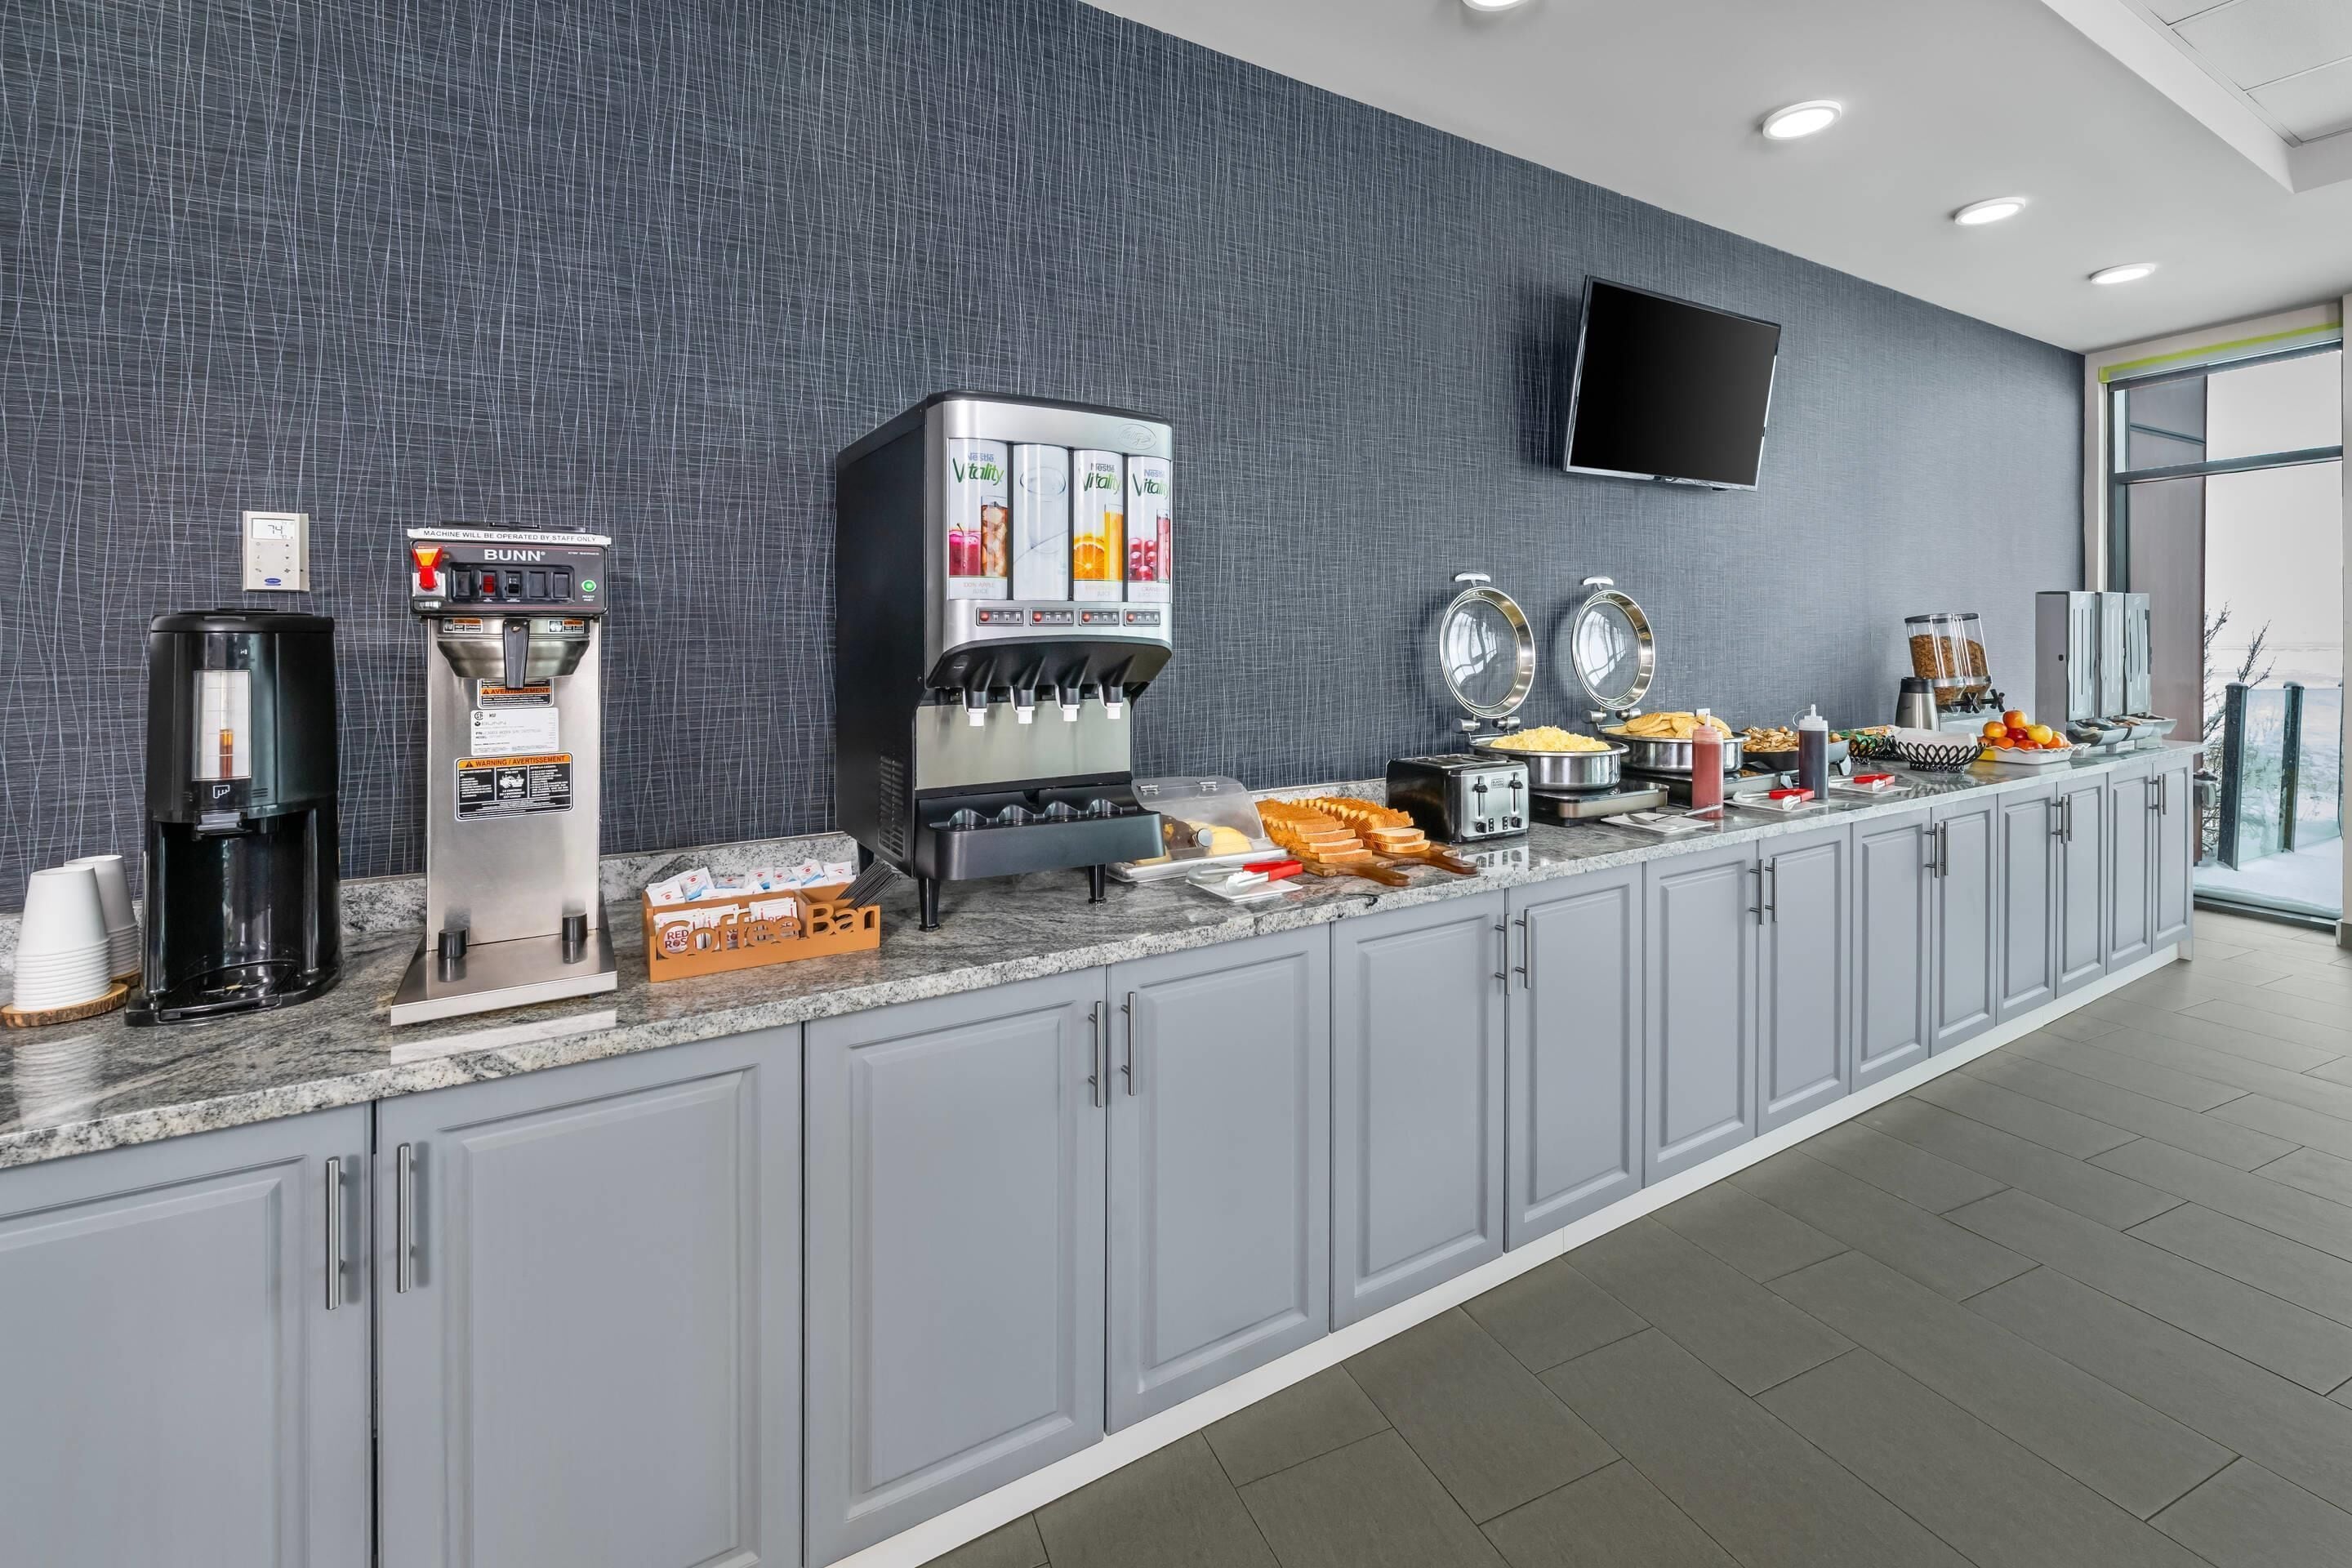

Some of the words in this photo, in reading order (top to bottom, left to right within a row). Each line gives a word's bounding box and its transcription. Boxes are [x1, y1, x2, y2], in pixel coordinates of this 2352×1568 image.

[952, 457, 1004, 486] Vtality
[268, 524, 283, 534] 74
[475, 759, 507, 768] WARNING
[513, 755, 565, 765] AVERTISSEMENT
[657, 910, 802, 960] Coffee
[806, 902, 878, 940] Bar
[667, 929, 689, 940] RED
[665, 938, 687, 949] ROS
